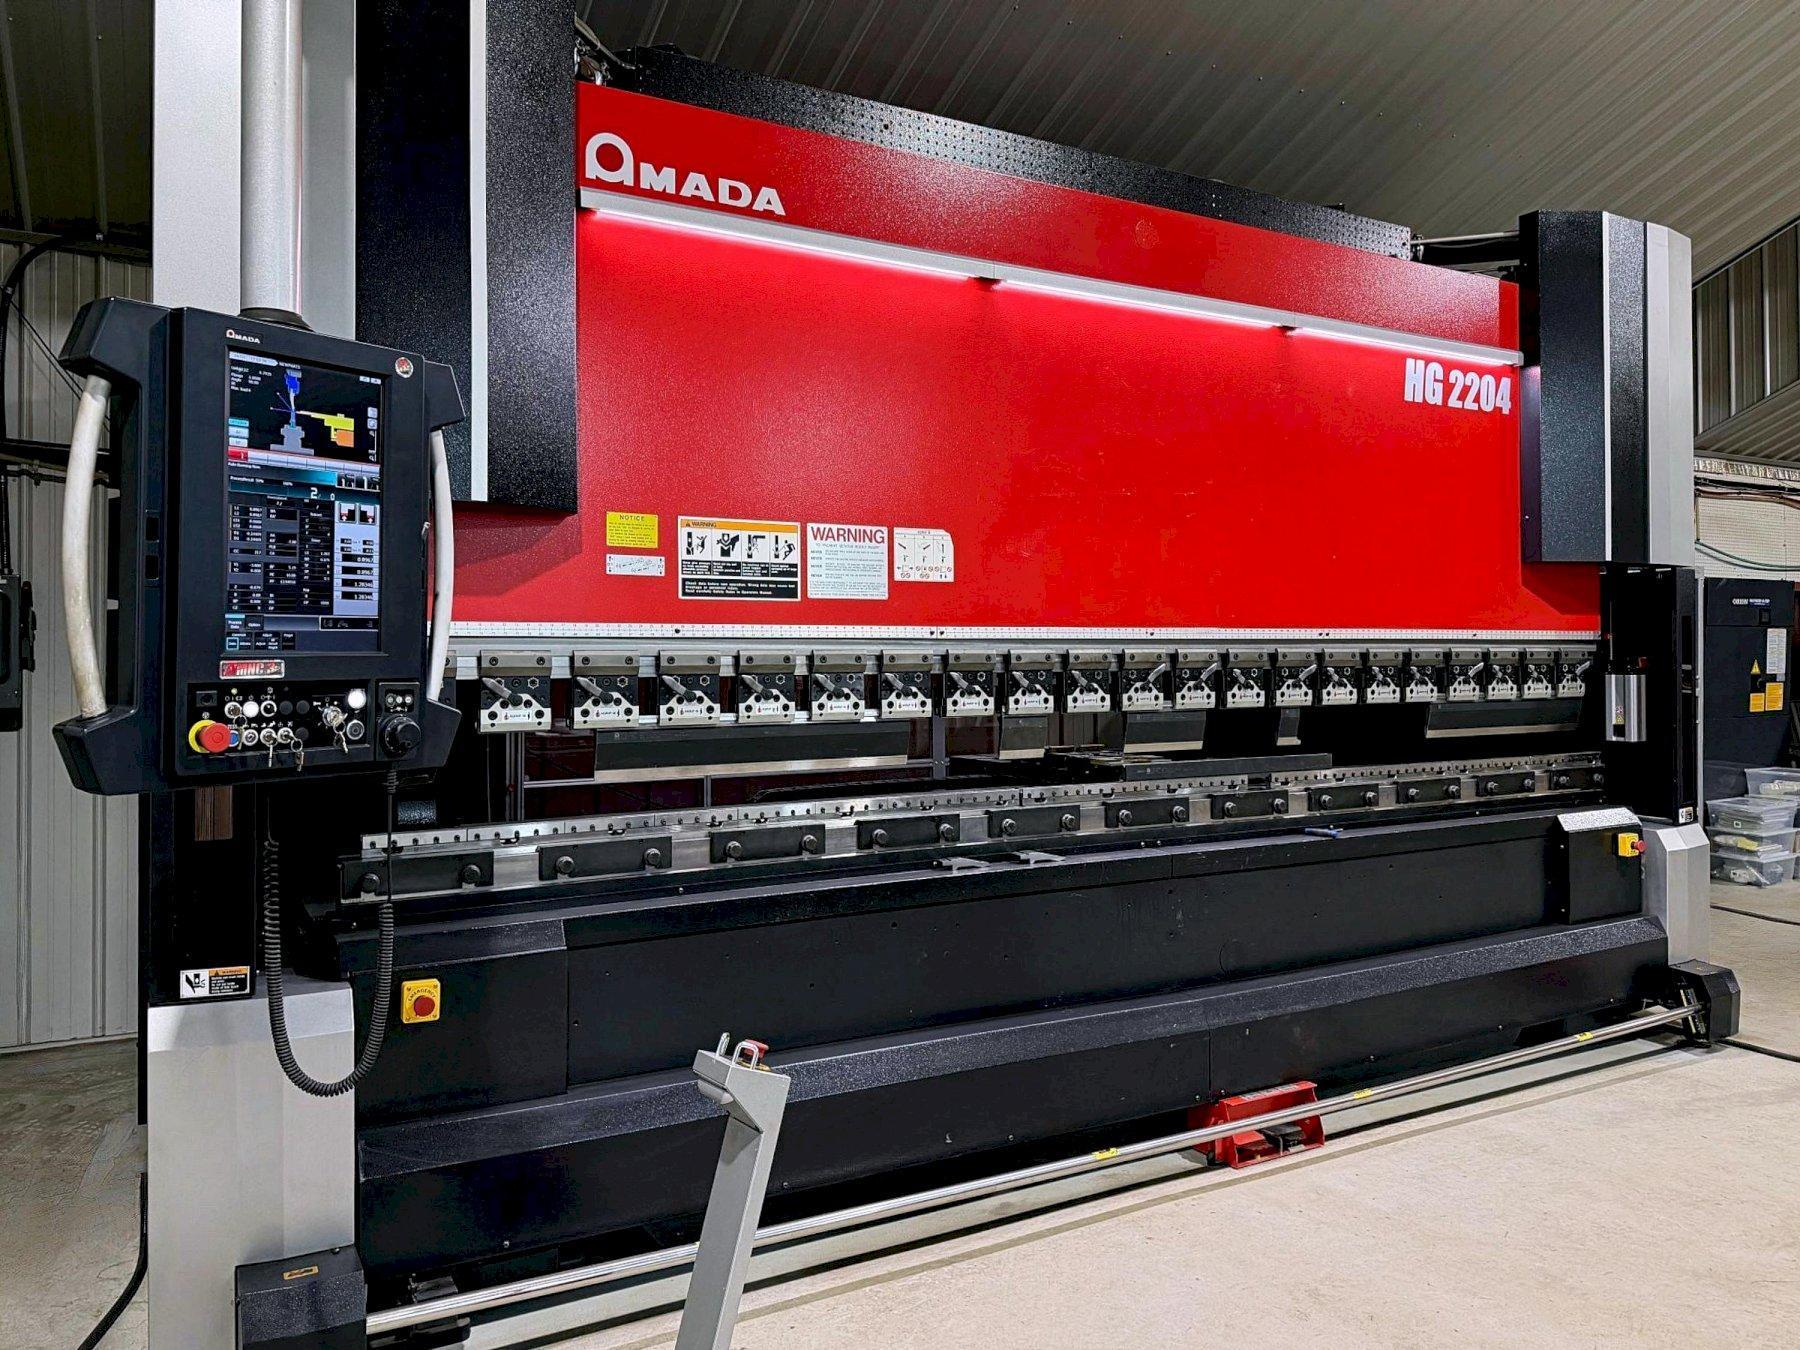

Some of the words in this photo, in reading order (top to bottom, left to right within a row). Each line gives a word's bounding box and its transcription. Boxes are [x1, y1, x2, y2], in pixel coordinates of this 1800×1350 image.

[585, 131, 786, 216] AMADA
[226, 329, 261, 344] AMADA
[1404, 357, 1444, 405] HG
[1447, 368, 1512, 415] 2204
[619, 514, 645, 522] NOTICE
[811, 526, 885, 544] WARNING
